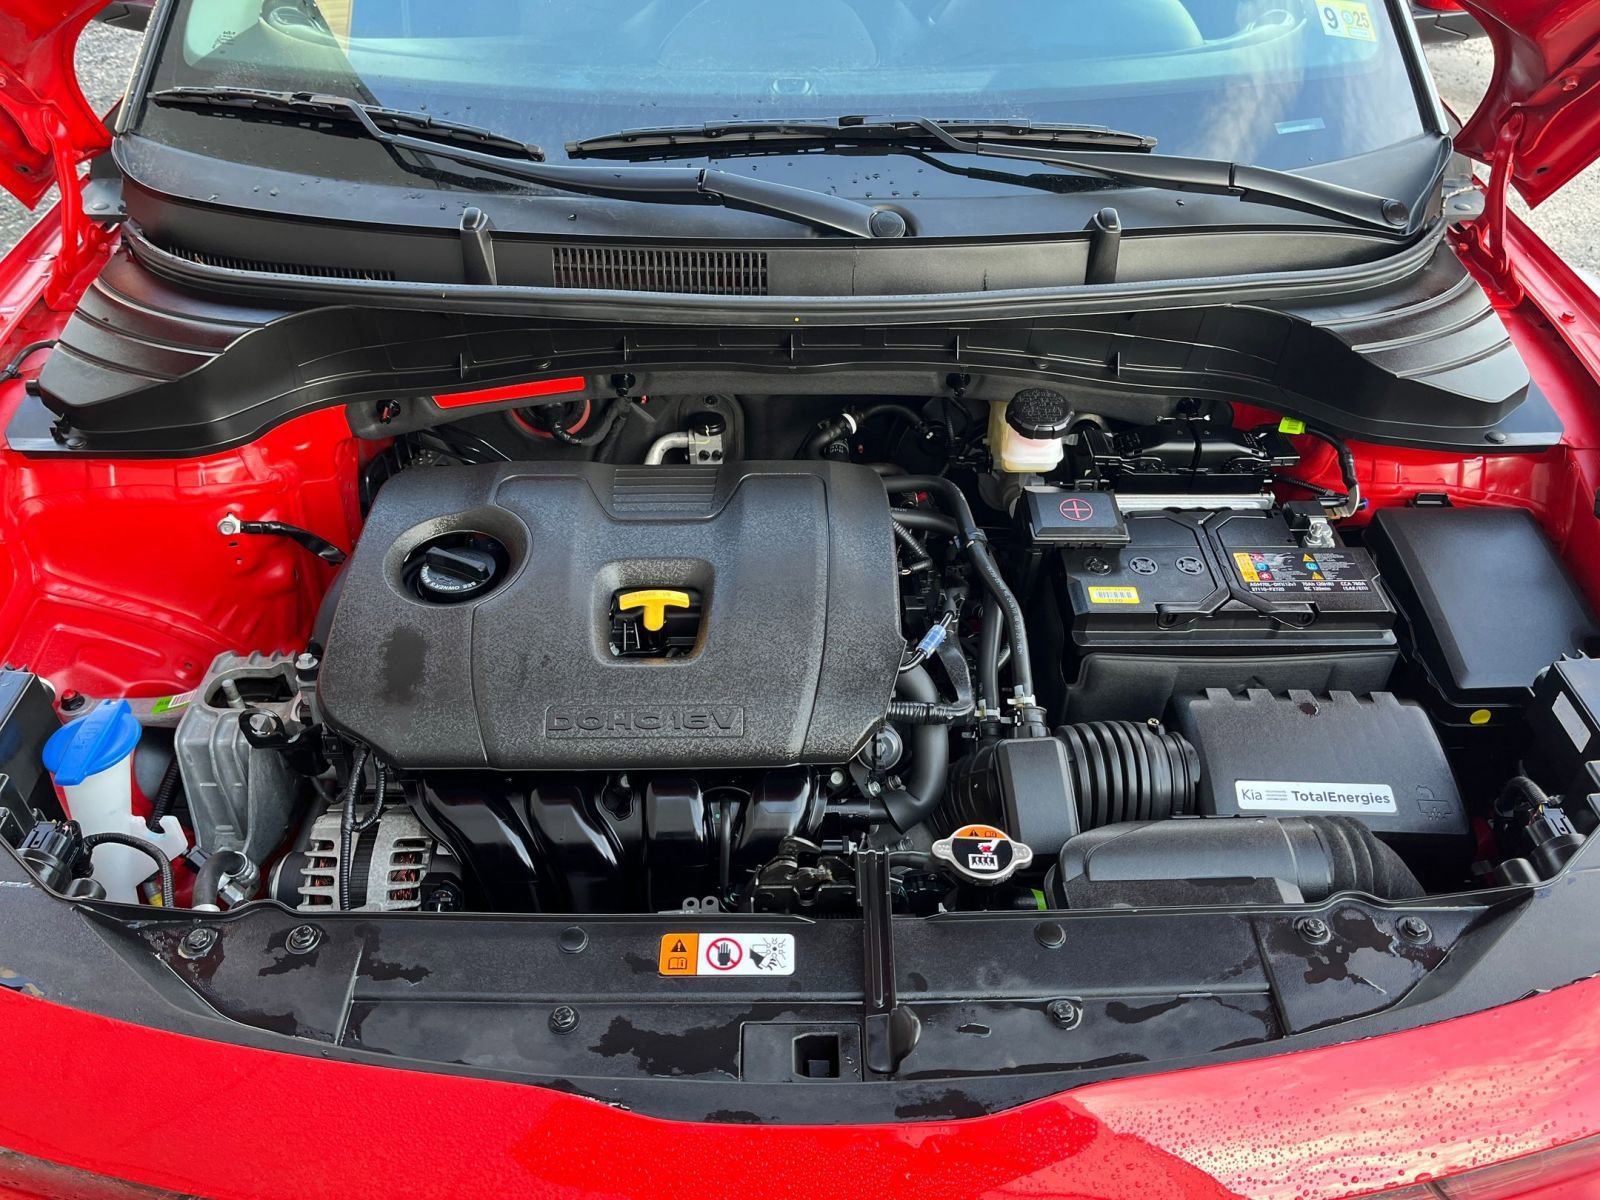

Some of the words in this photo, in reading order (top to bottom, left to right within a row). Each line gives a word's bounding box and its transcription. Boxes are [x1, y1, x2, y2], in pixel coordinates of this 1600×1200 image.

[1323, 7, 1338, 30] 9
[1353, 11, 1370, 29] 25
[547, 711, 662, 731] DOHC
[672, 711, 736, 730] 16V
[1241, 789, 1263, 801] Kia
[1291, 790, 1391, 805] TotalEnergies
